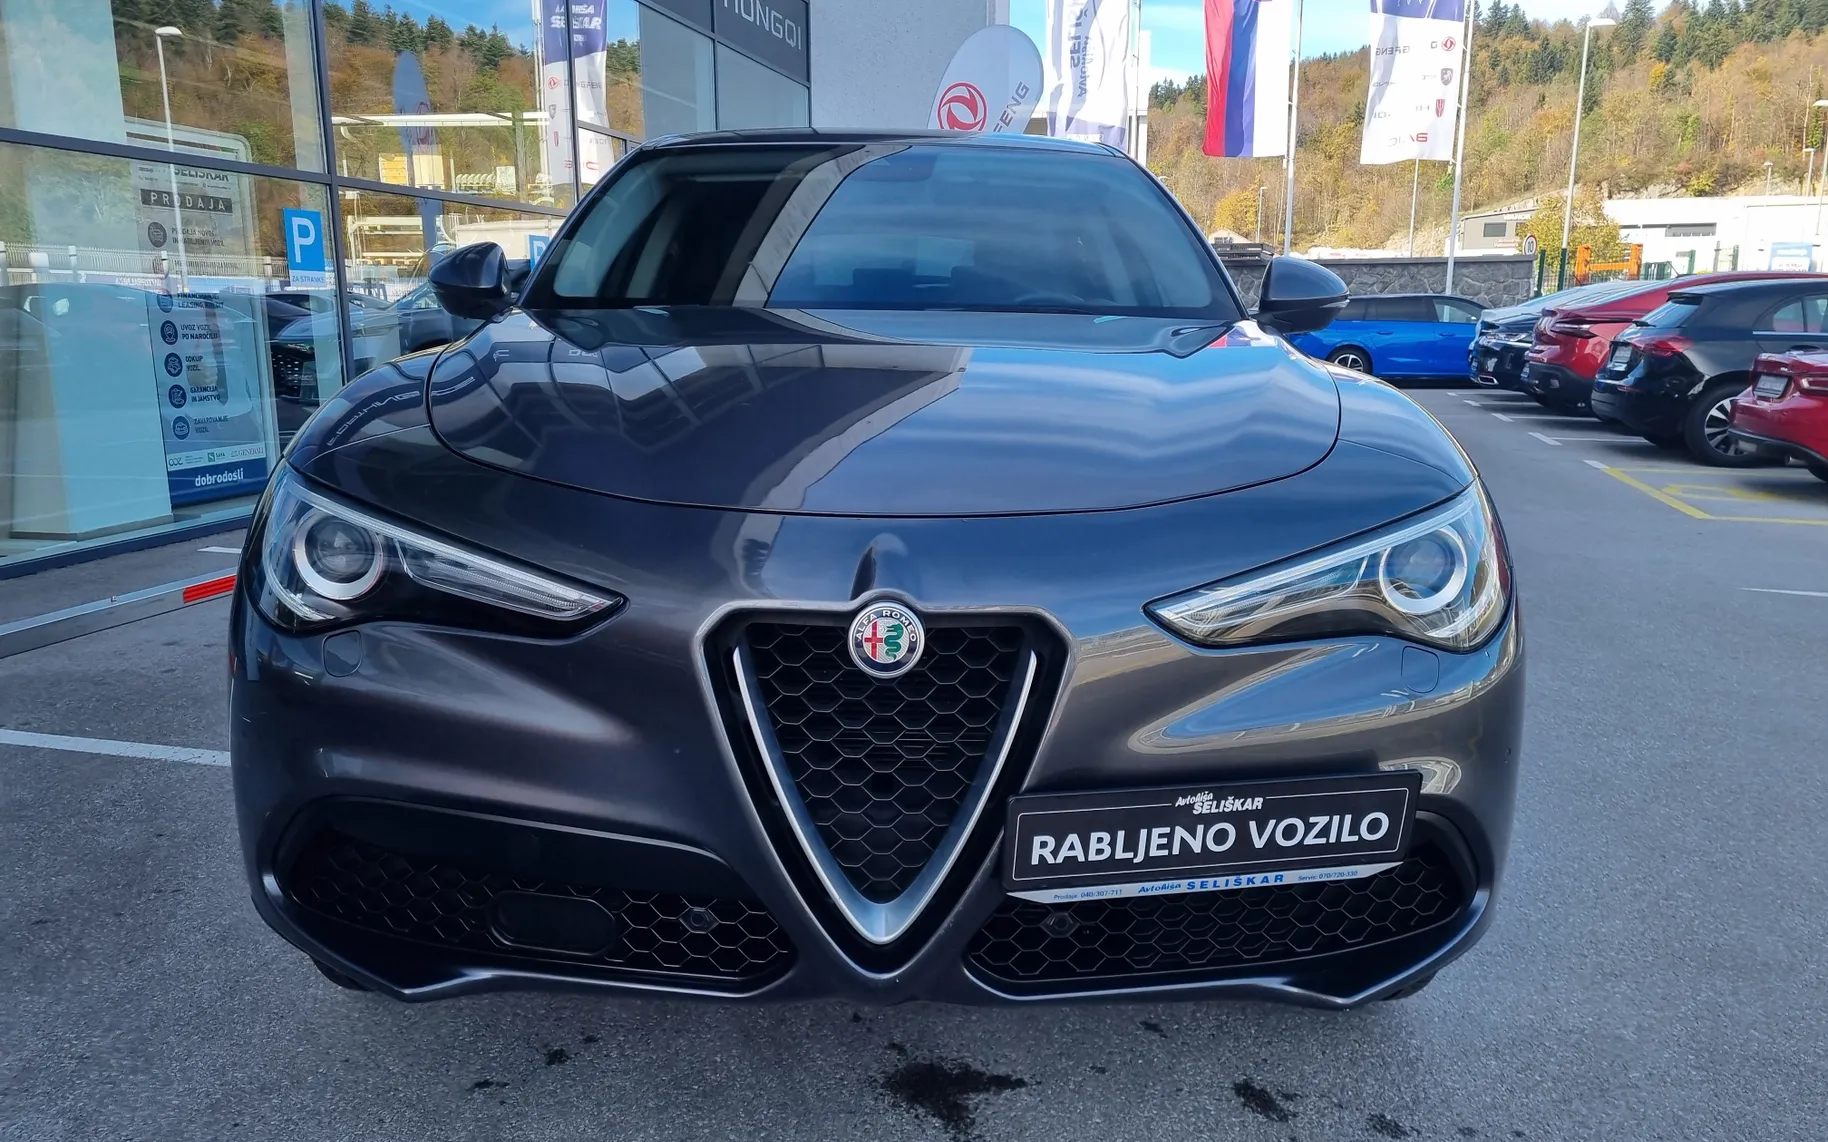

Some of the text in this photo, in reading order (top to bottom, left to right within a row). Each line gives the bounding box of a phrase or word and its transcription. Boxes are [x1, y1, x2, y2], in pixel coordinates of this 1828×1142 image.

[150, 192, 226, 211] PRODAJA
[292, 217, 315, 263] P
[195, 468, 244, 487] dobrodošli
[855, 610, 917, 642] ALFA ROMEO
[1193, 796, 1263, 815] SELIŠKAR
[1031, 811, 1389, 865] RABLJENO VOZILO
[1186, 874, 1284, 890] SELIŠKAR
